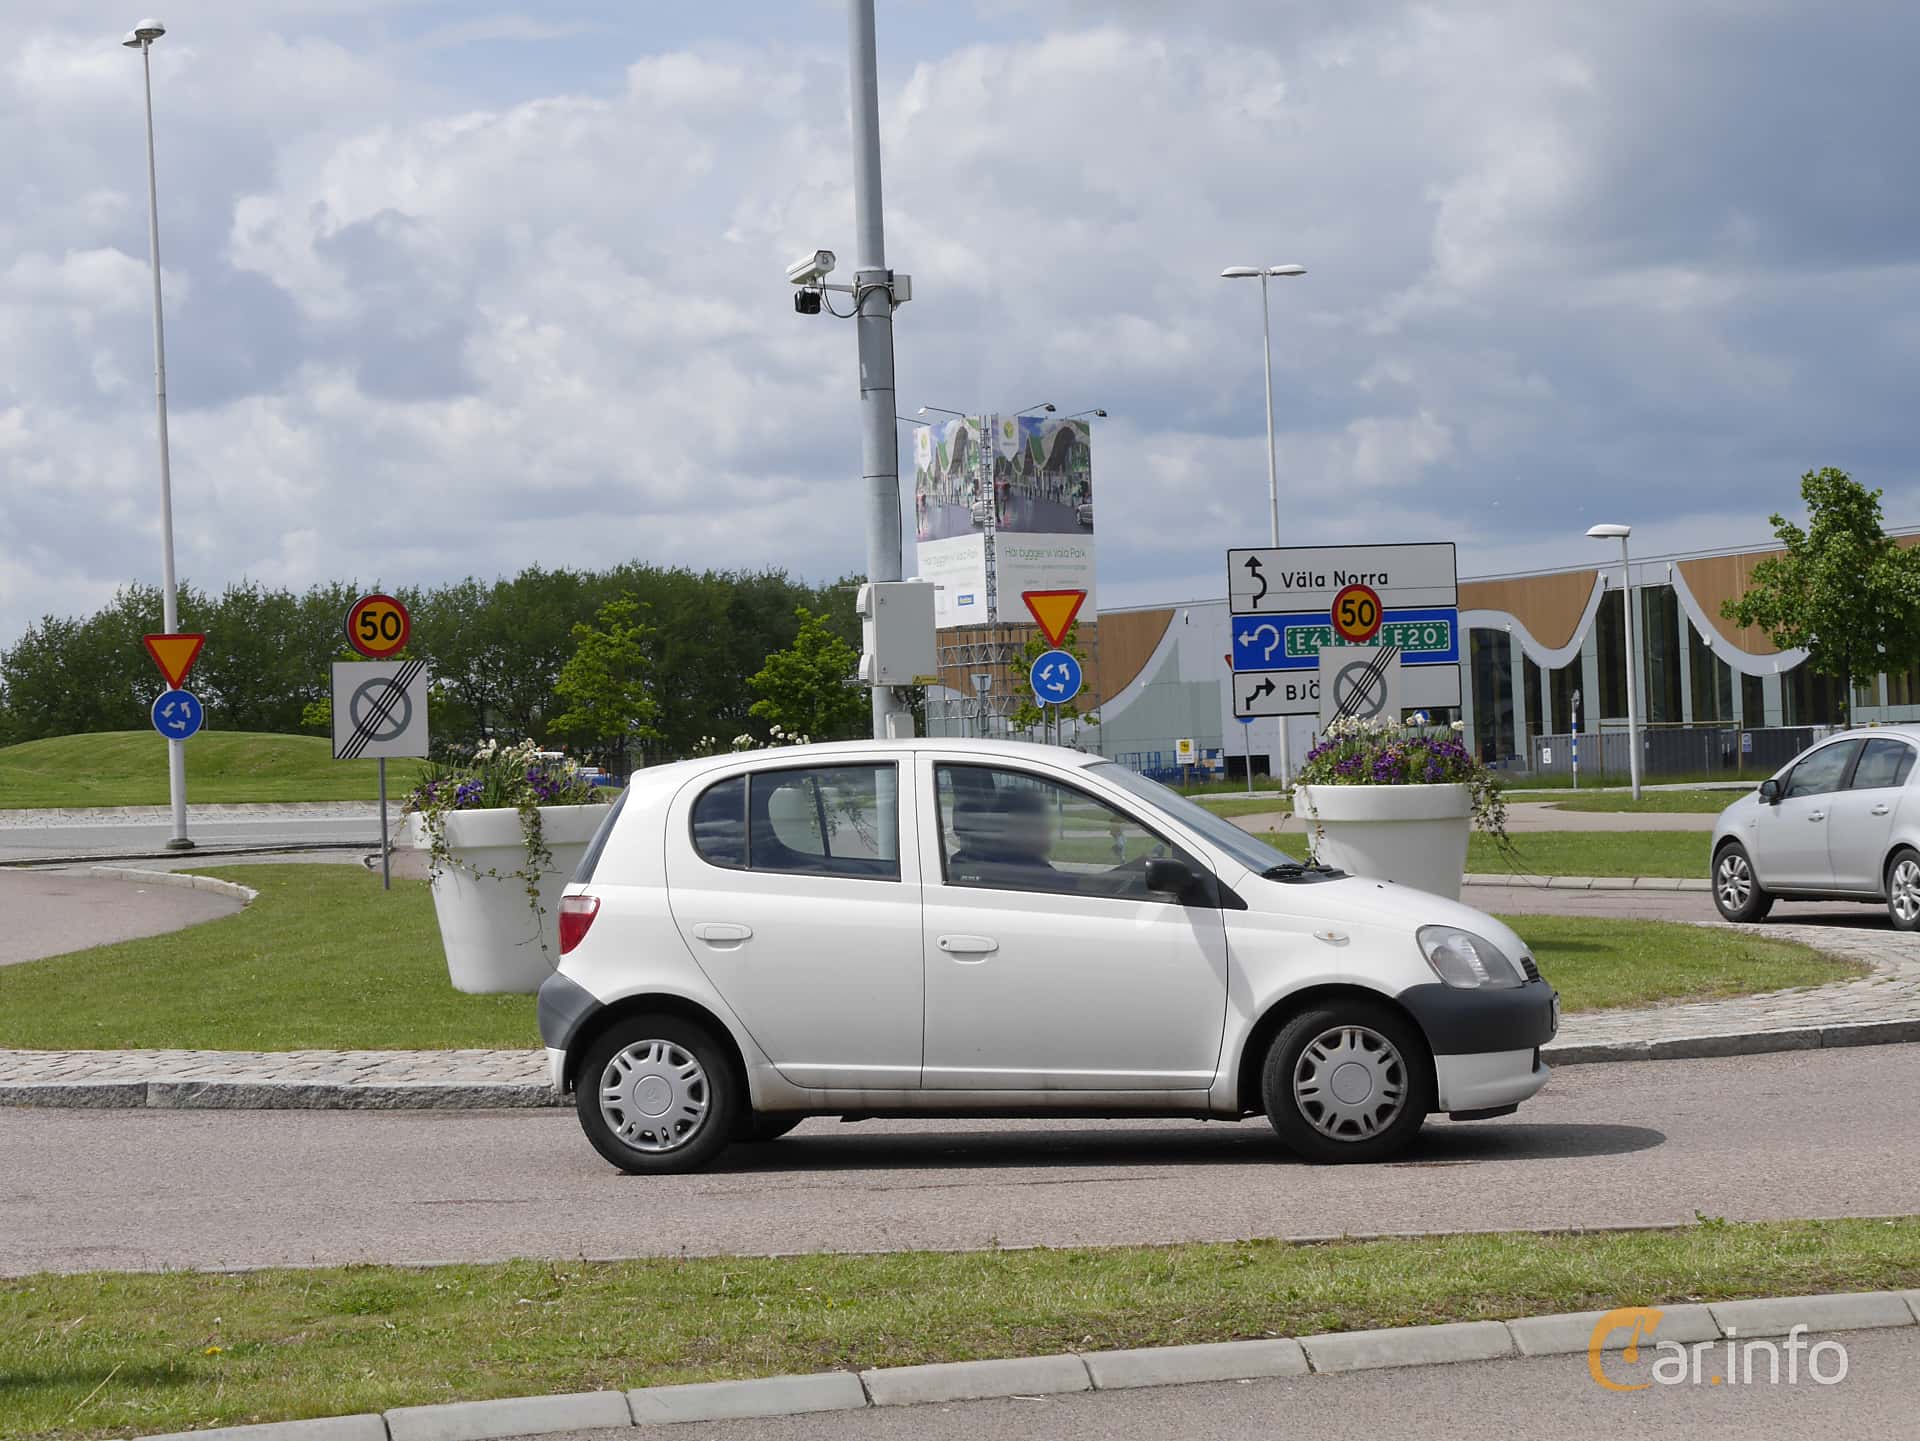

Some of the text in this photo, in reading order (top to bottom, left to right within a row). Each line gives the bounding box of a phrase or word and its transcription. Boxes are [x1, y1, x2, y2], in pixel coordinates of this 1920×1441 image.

[1281, 570, 1388, 588] Väla Norra
[1341, 599, 1376, 627] 50
[361, 611, 401, 641] 50
[1296, 632, 1322, 650] E4
[1394, 628, 1437, 645] E20
[1286, 679, 1320, 700] BJÖ
